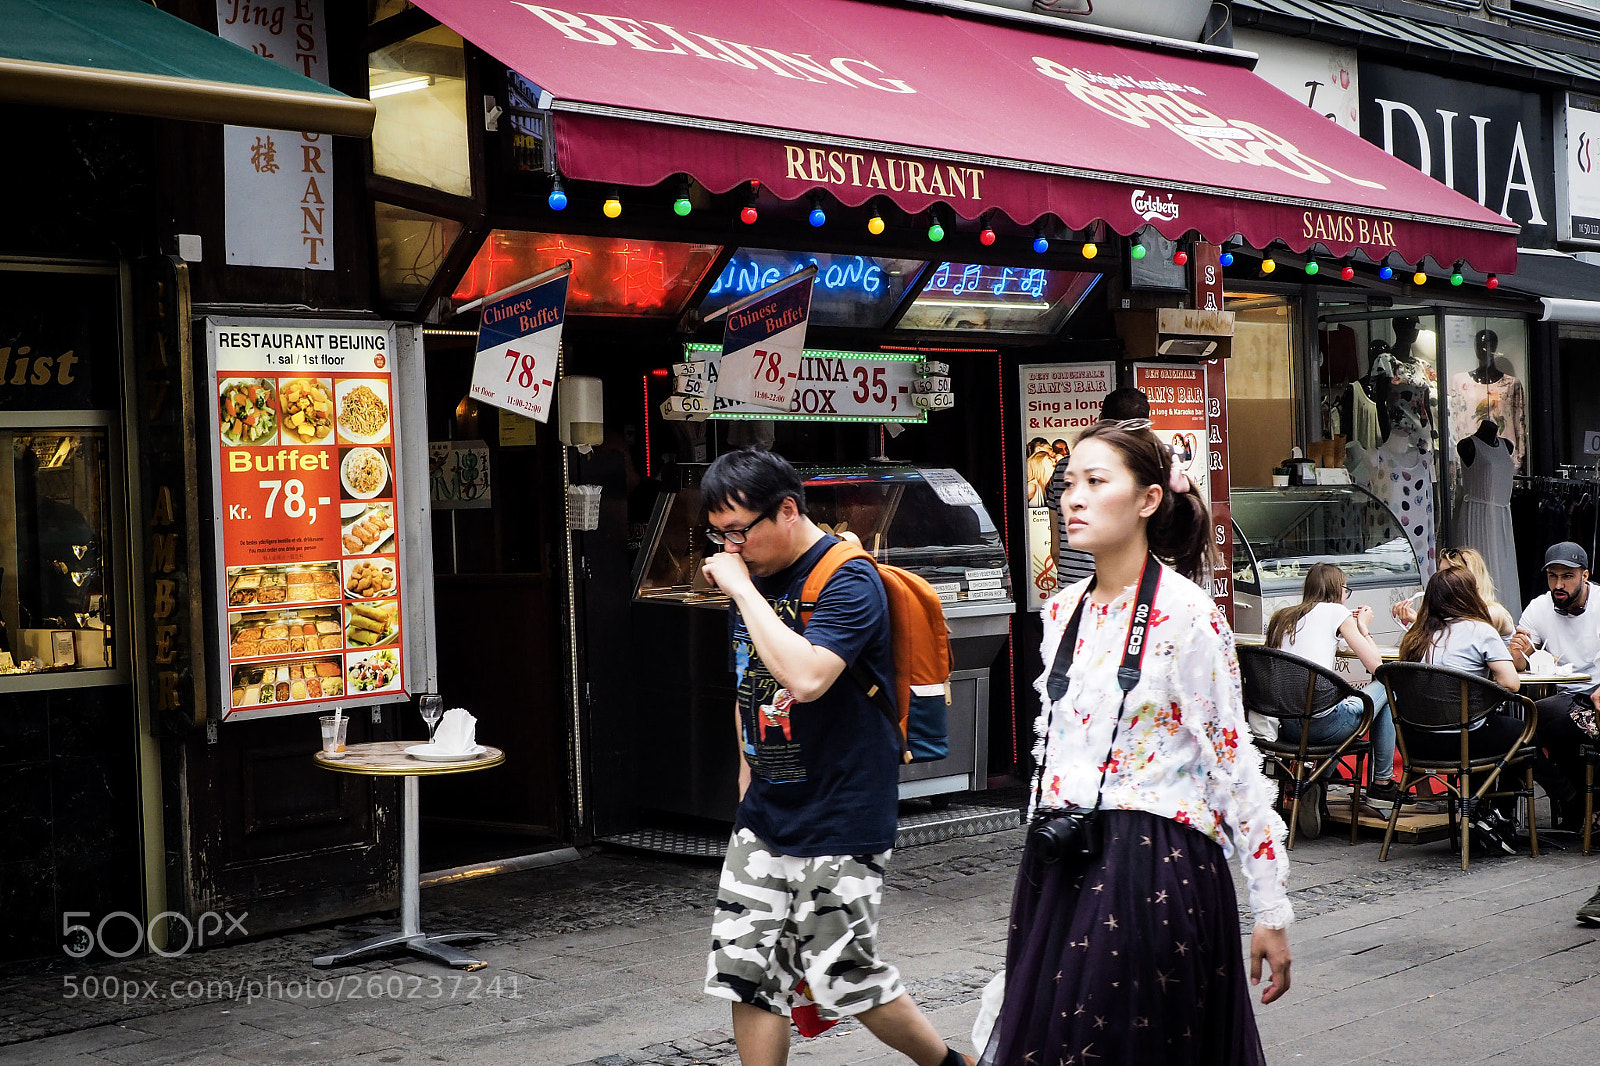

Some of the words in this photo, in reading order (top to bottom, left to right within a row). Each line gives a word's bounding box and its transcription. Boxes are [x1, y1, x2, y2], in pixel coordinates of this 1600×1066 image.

[510, 1, 917, 95] BEIJING
[784, 145, 984, 200] RESTAURANT
[1131, 189, 1179, 221] Carlsberg
[1303, 211, 1353, 242] SAMS
[1357, 218, 1397, 246] BAR
[483, 298, 533, 325] Chinese
[519, 305, 560, 332] Buffet
[728, 301, 778, 331] Chinese
[765, 306, 803, 333] Buffet
[219, 333, 324, 349] RESTAURANT
[329, 335, 386, 351] BEIJING
[266, 354, 275, 365] 1.
[278, 354, 294, 365] sal
[302, 354, 319, 365] 1st
[321, 354, 345, 366] floor
[1028, 381, 1071, 394] SAM'S
[1074, 380, 1107, 393] BAR
[1177, 386, 1204, 403] BAR
[1028, 400, 1060, 413] Sing
[1063, 402, 1072, 410] a
[1029, 417, 1040, 428] &
[228, 449, 330, 473] Buffet
[229, 504, 252, 520] Kr.
[259, 478, 331, 525] 78,-
[1135, 603, 1149, 624] 70D
[1128, 625, 1145, 656] EOS
